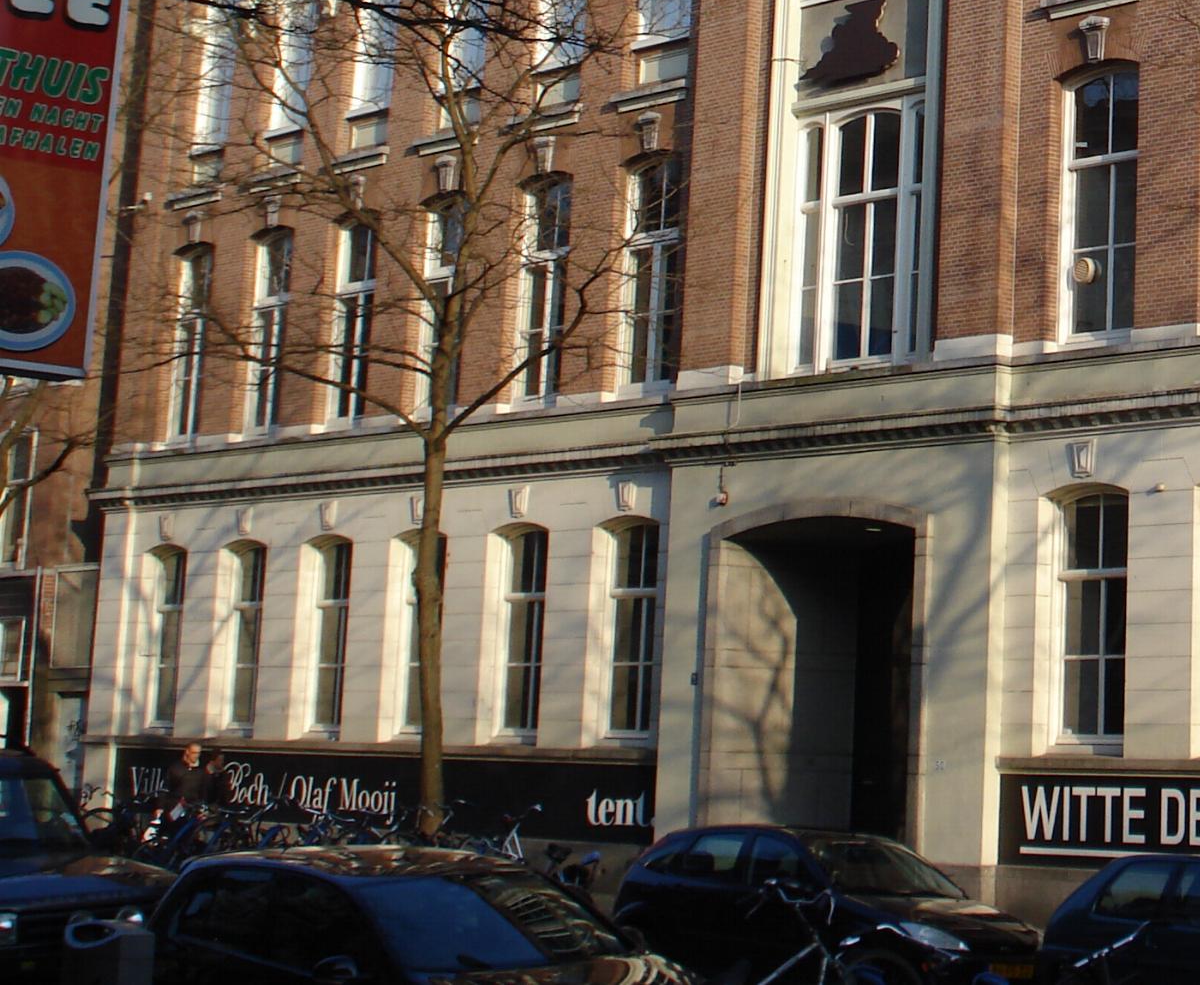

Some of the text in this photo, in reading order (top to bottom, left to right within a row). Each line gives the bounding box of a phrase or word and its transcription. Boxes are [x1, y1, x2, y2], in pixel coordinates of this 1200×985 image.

[0, 46, 110, 105] THUIS
[30, 102, 105, 133] NACHT
[290, 775, 338, 820] Olaf
[338, 778, 397, 825] Mooij
[1020, 785, 1147, 844] WITTE
